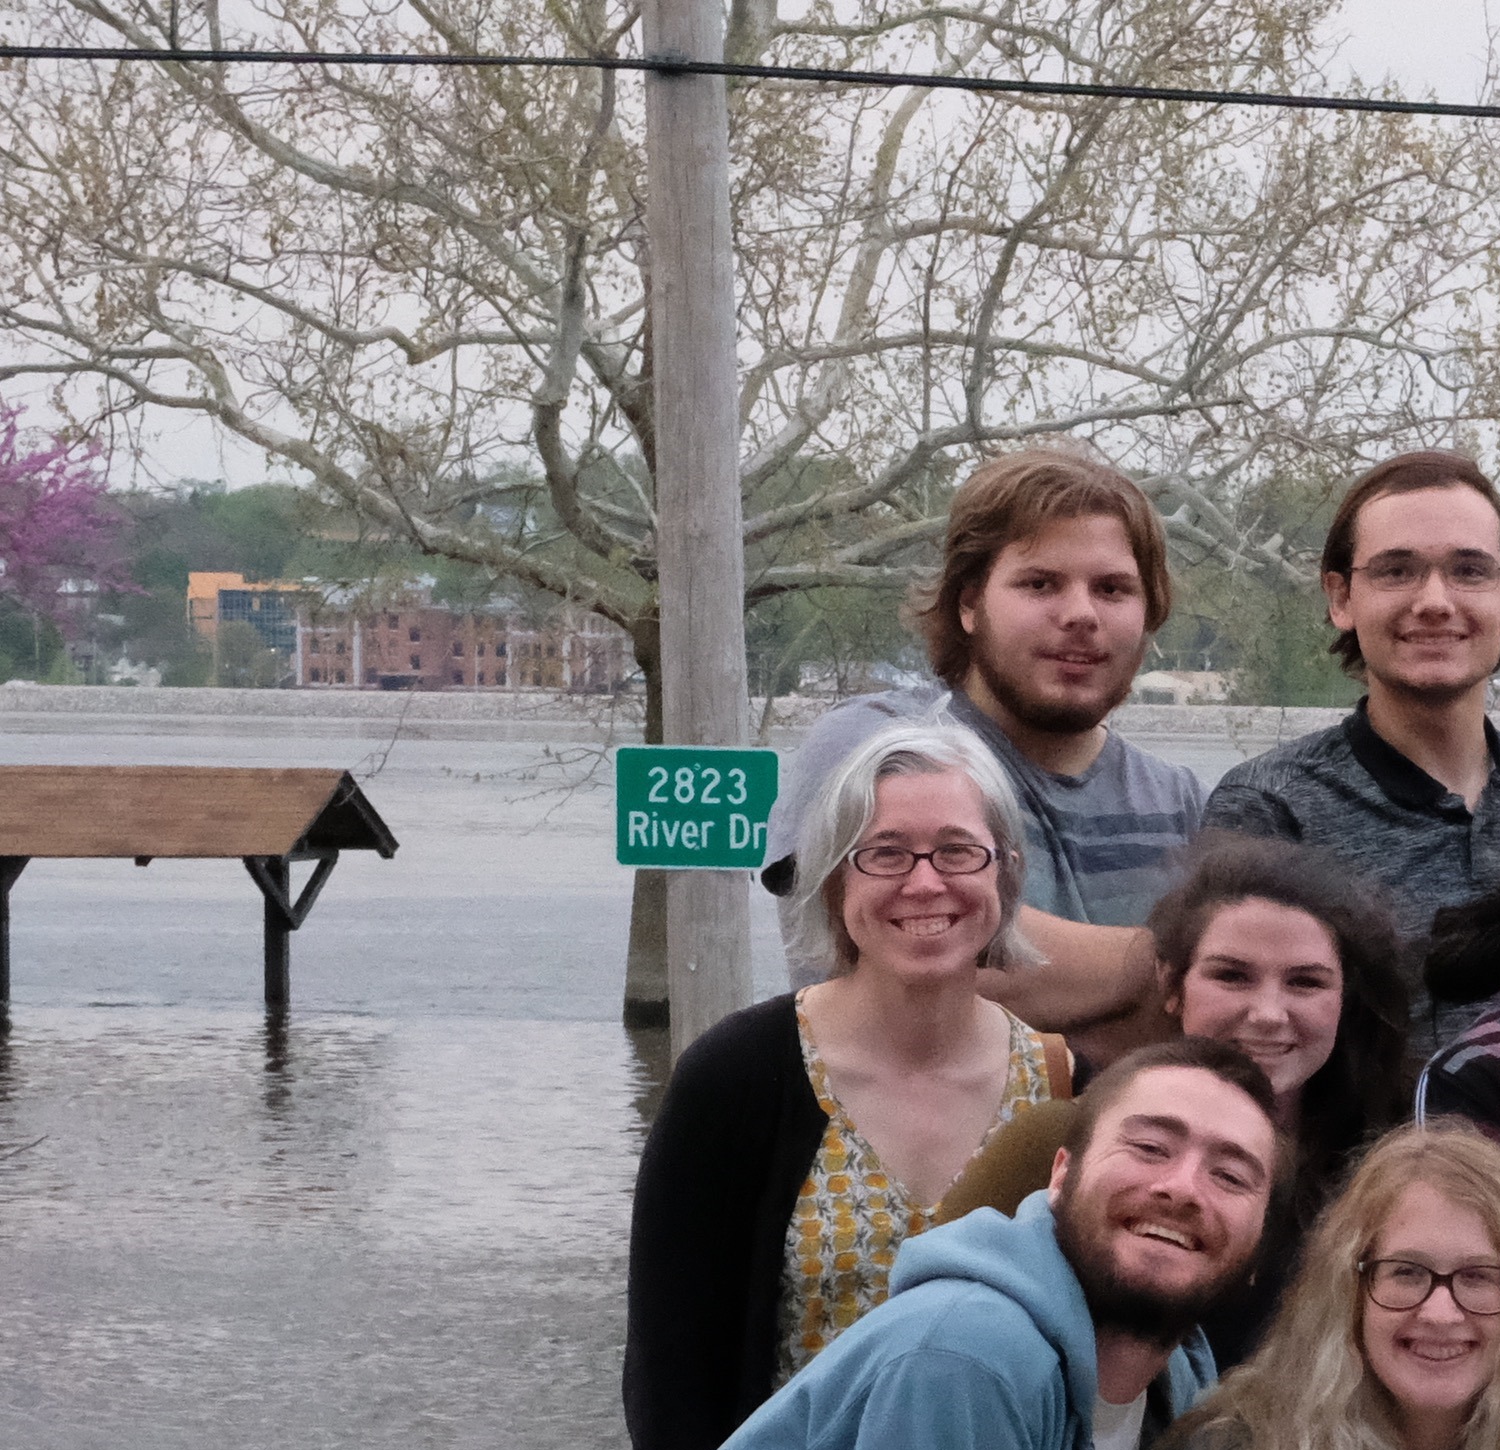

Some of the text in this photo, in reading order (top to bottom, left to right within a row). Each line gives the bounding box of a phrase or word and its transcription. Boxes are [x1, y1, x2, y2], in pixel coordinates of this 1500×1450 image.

[648, 766, 747, 804] 2823
[628, 811, 767, 849] River Dr
